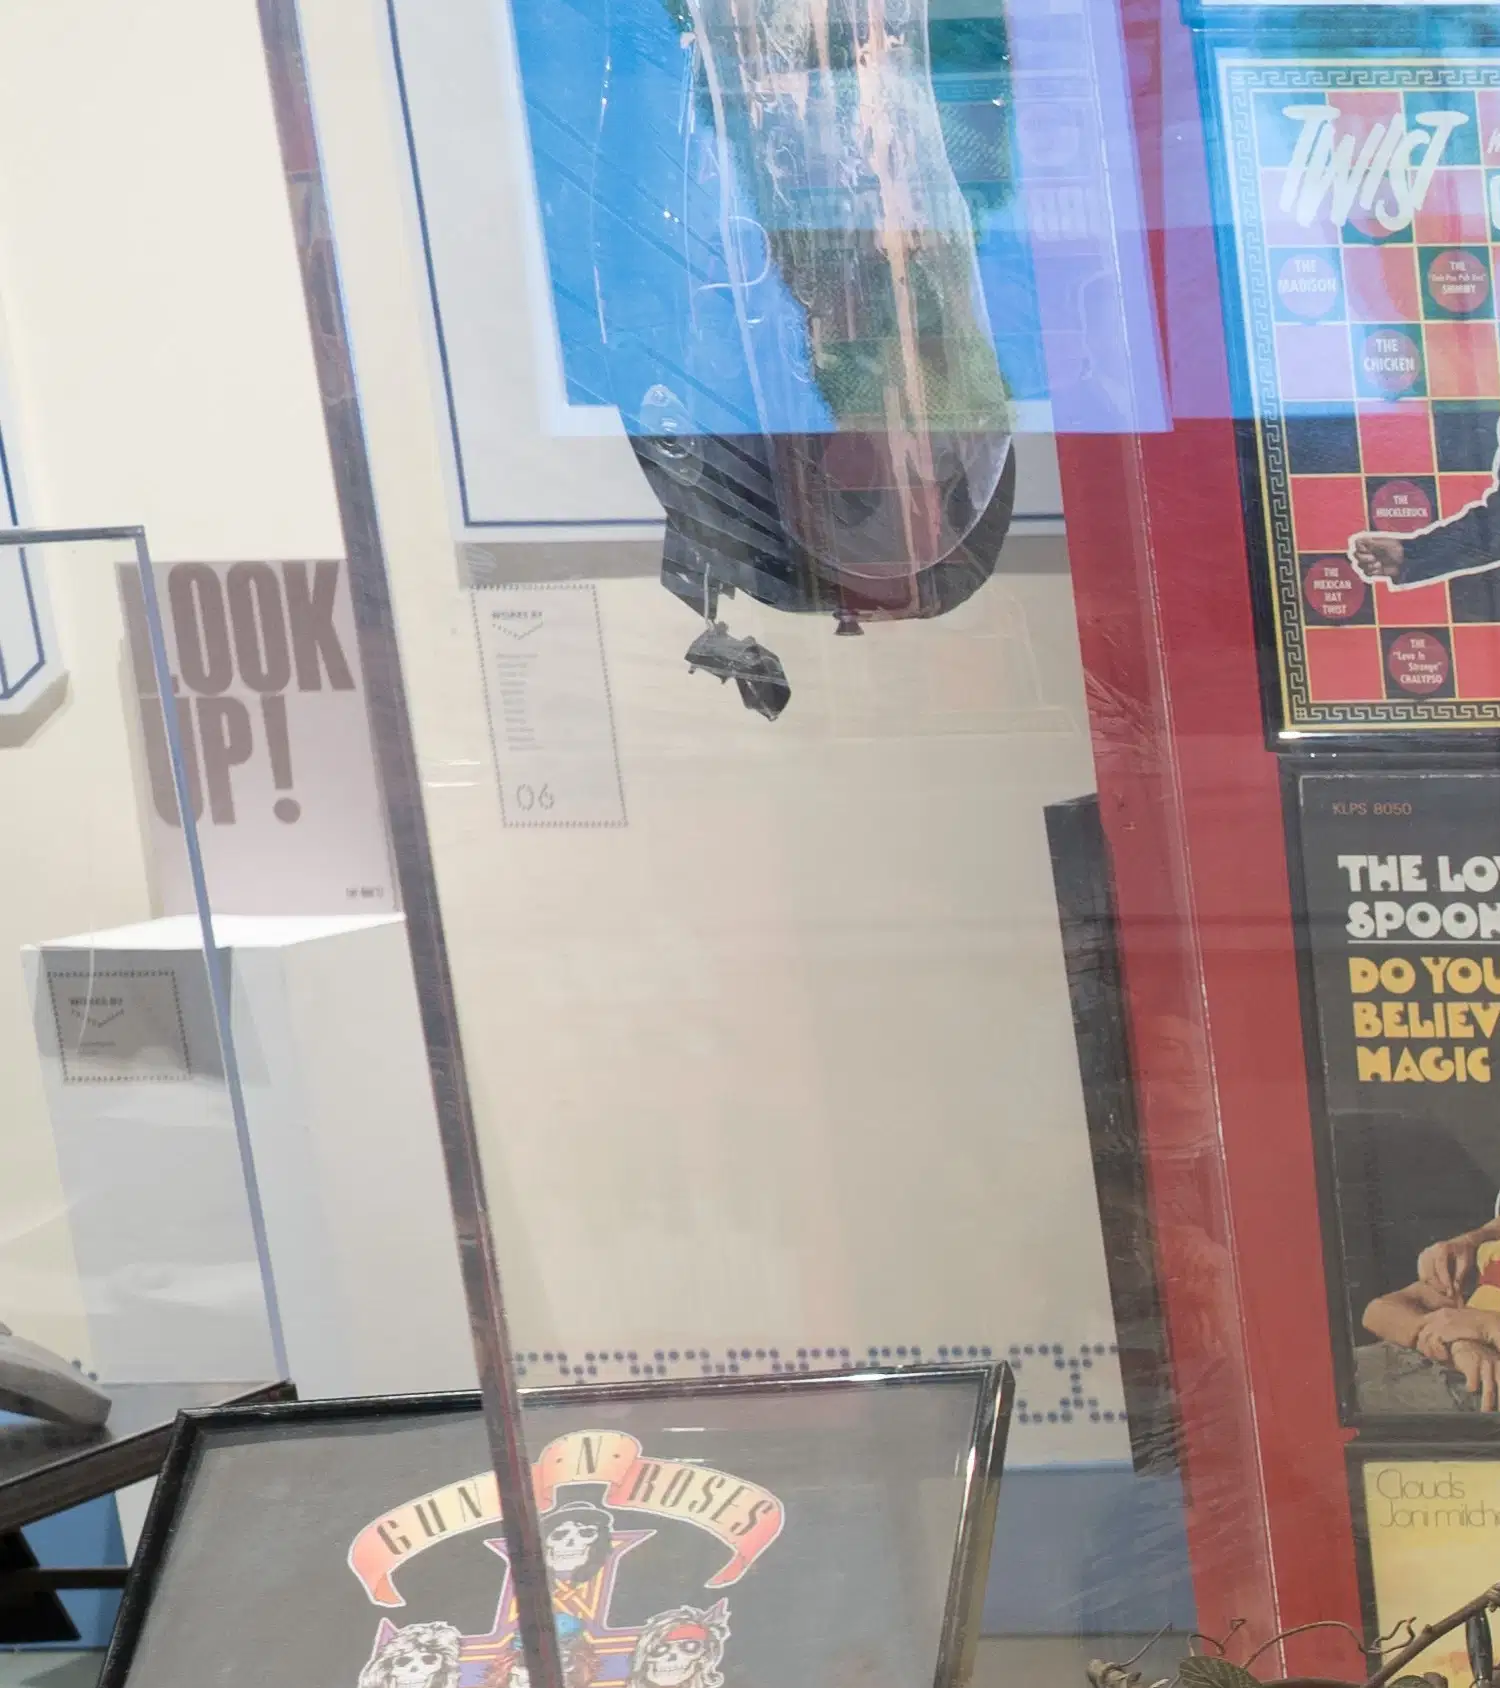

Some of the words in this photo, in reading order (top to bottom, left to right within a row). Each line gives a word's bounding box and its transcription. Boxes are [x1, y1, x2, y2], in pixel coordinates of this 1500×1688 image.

[1281, 104, 1470, 232] TWIST
[138, 694, 302, 829] UP!
[1337, 854, 1428, 892] THE
[1348, 956, 1416, 994] DO
[1356, 1046, 1491, 1083] MAGIC
[627, 1461, 776, 1538] ROSES
